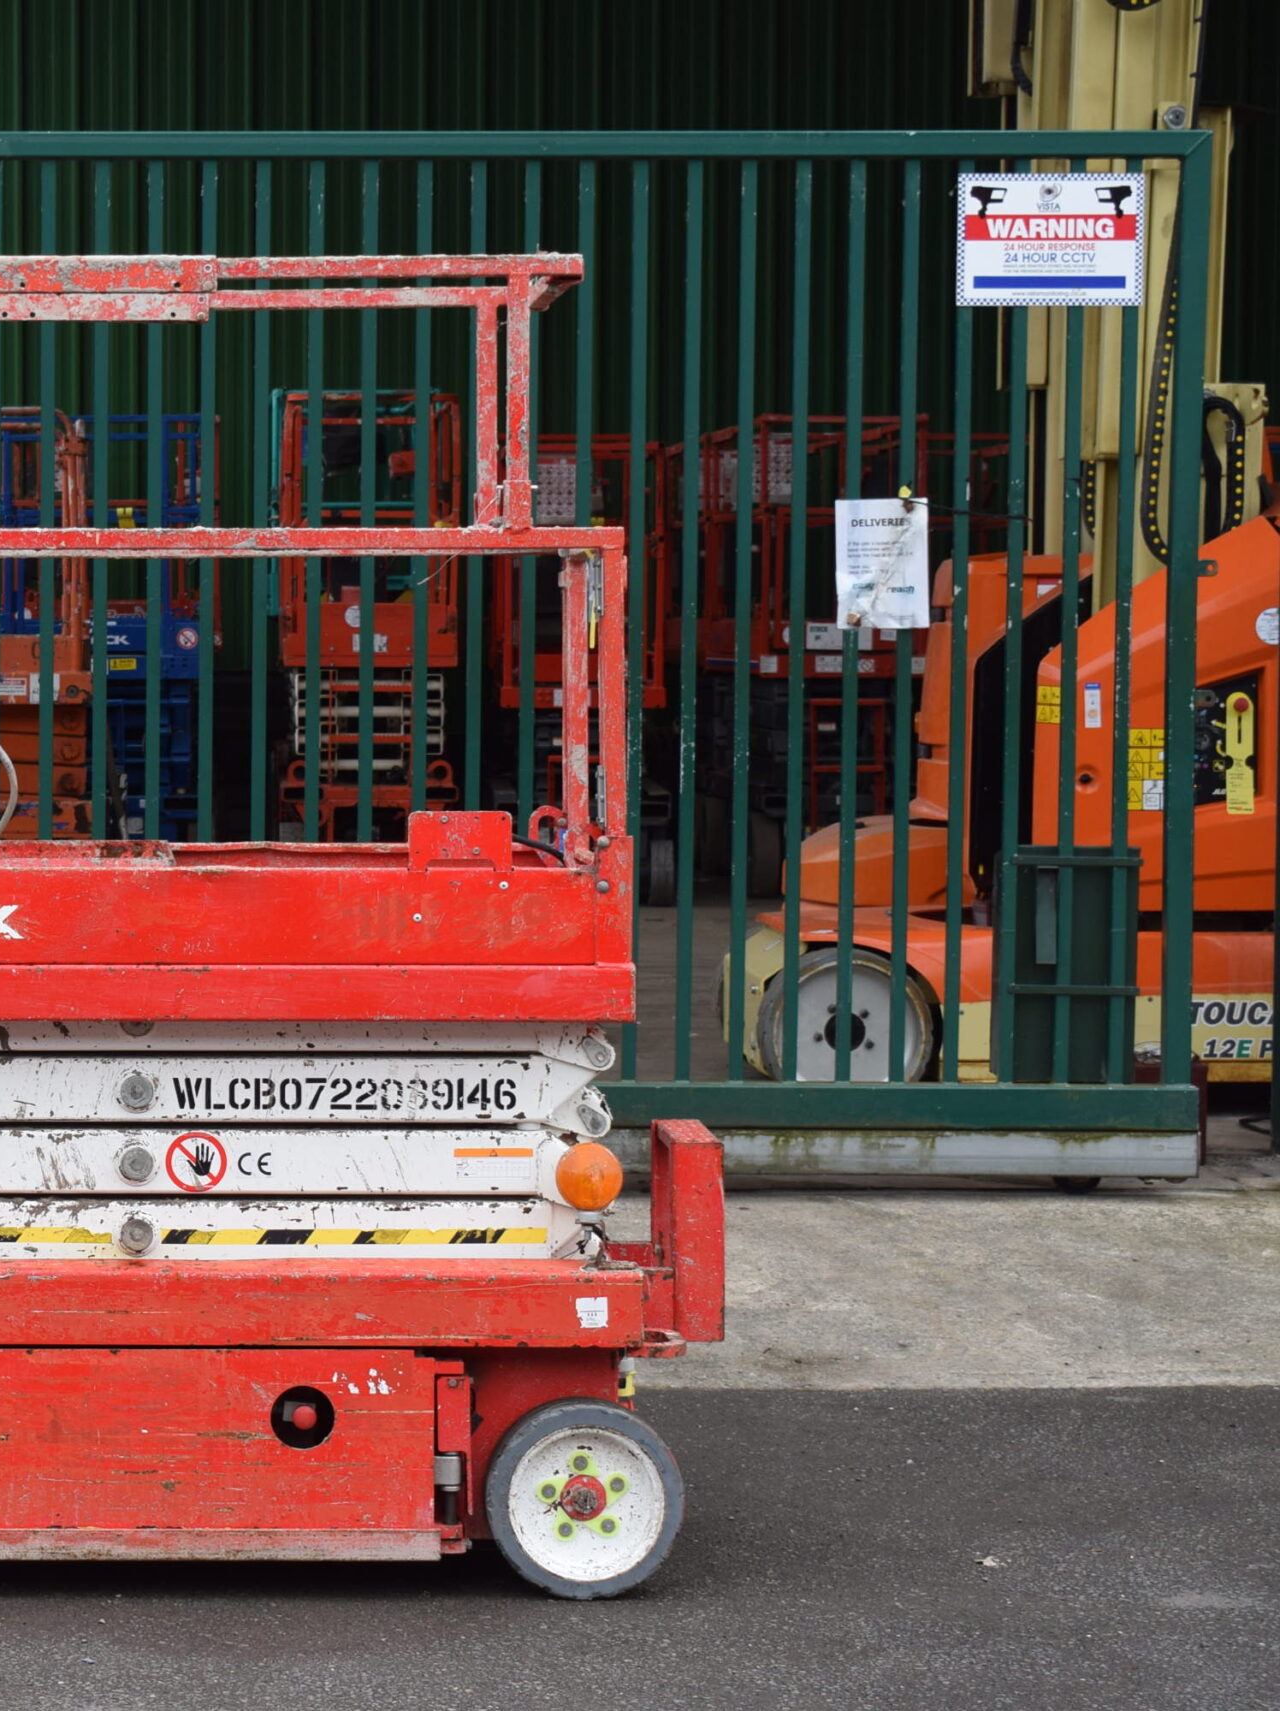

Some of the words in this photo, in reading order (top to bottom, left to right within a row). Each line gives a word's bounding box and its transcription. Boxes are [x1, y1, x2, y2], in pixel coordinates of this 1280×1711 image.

[986, 218, 1115, 239] WARNING
[1003, 243, 1015, 251] 24
[1017, 243, 1045, 251] HOUR
[1048, 243, 1096, 251] RESPONSE
[1004, 252, 1018, 263] 24
[1022, 252, 1057, 263] HOUR
[1061, 252, 1096, 263] CCTV
[851, 517, 912, 528] DELIVERIES
[1190, 1001, 1274, 1025] TOUC
[1203, 1039, 1252, 1058] 12E
[237, 1152, 271, 1176] CE
